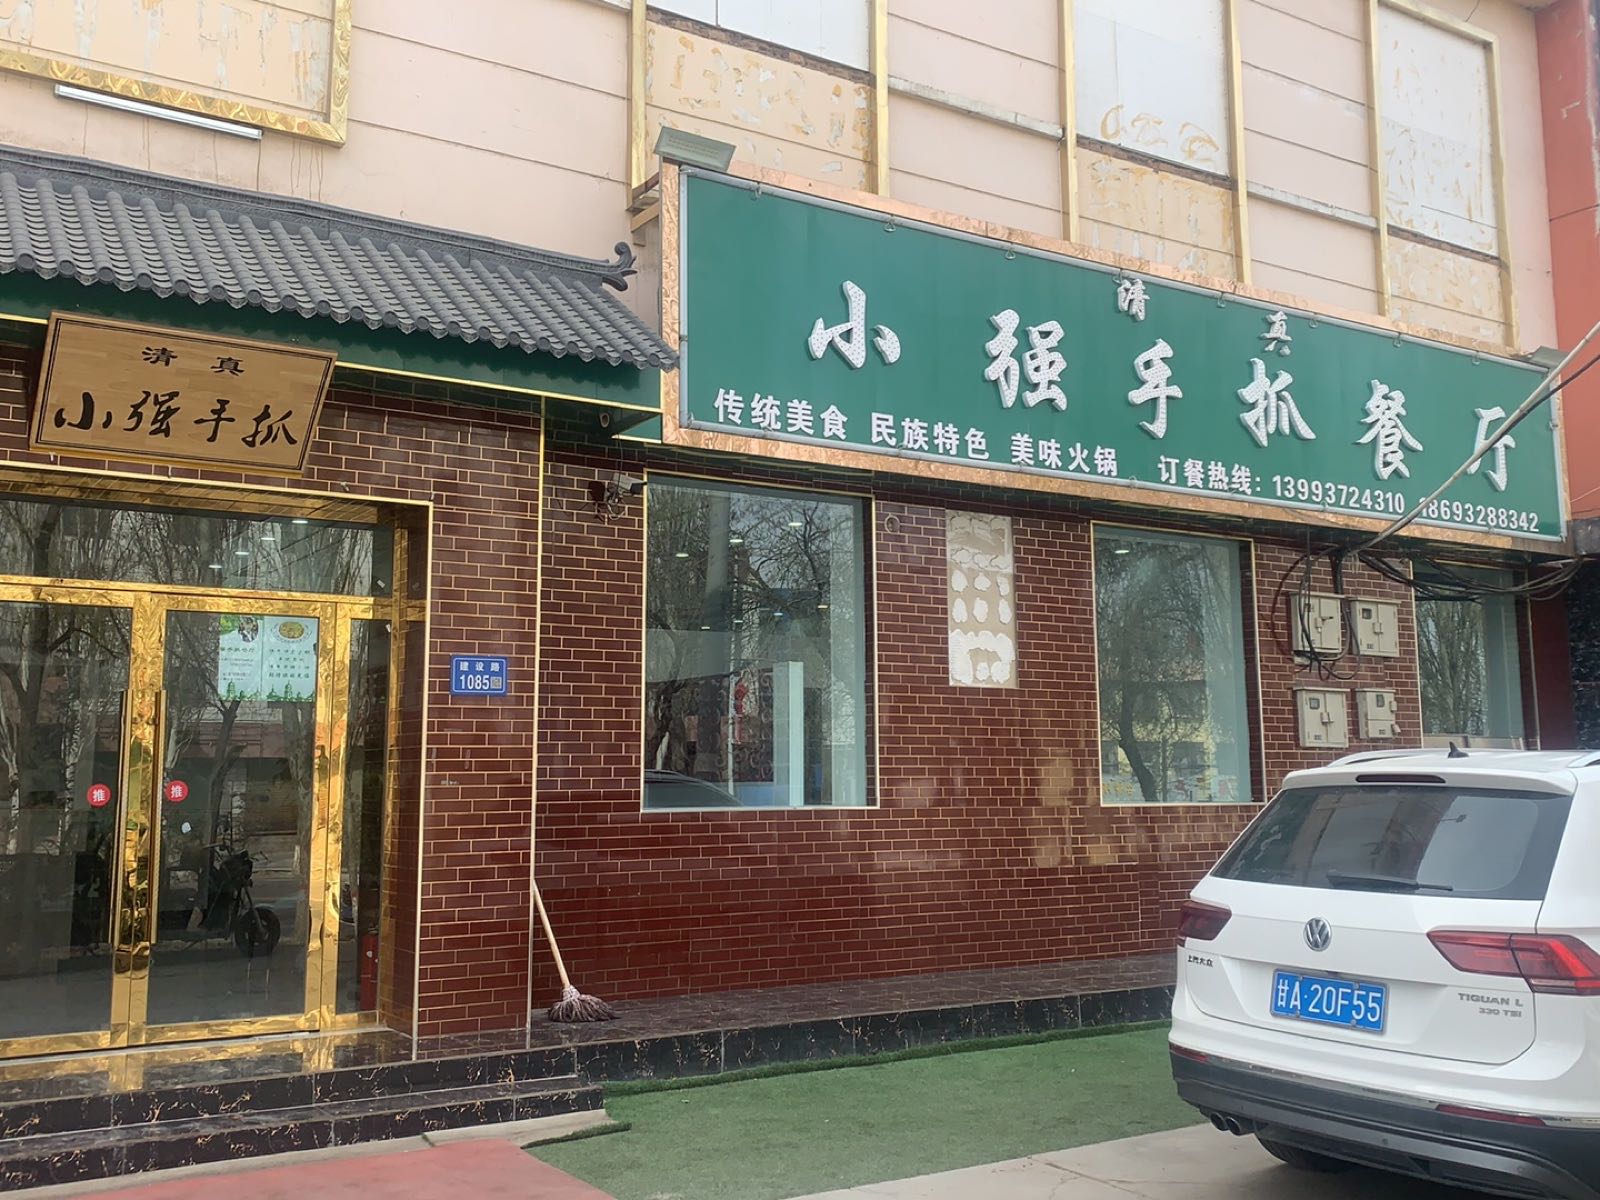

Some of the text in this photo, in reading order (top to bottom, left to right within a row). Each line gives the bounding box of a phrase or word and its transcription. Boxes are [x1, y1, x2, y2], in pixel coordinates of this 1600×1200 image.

[1117, 278, 1293, 356] 清真
[141, 346, 245, 376] 清真
[807, 280, 1516, 491] 小强手抓餐厅
[54, 390, 298, 448] 小强手抓
[713, 387, 849, 440] 传统美食
[870, 411, 990, 460] 民族特色
[1010, 431, 1119, 477] 美味火锅
[1271, 474, 1405, 513] 13993724310
[460, 674, 490, 690] 1085
[92, 788, 106, 802] 推
[170, 785, 183, 798] 推
[1457, 992, 1524, 1007] TIGUAN L
[1479, 1007, 1522, 1018] 330 TSI
